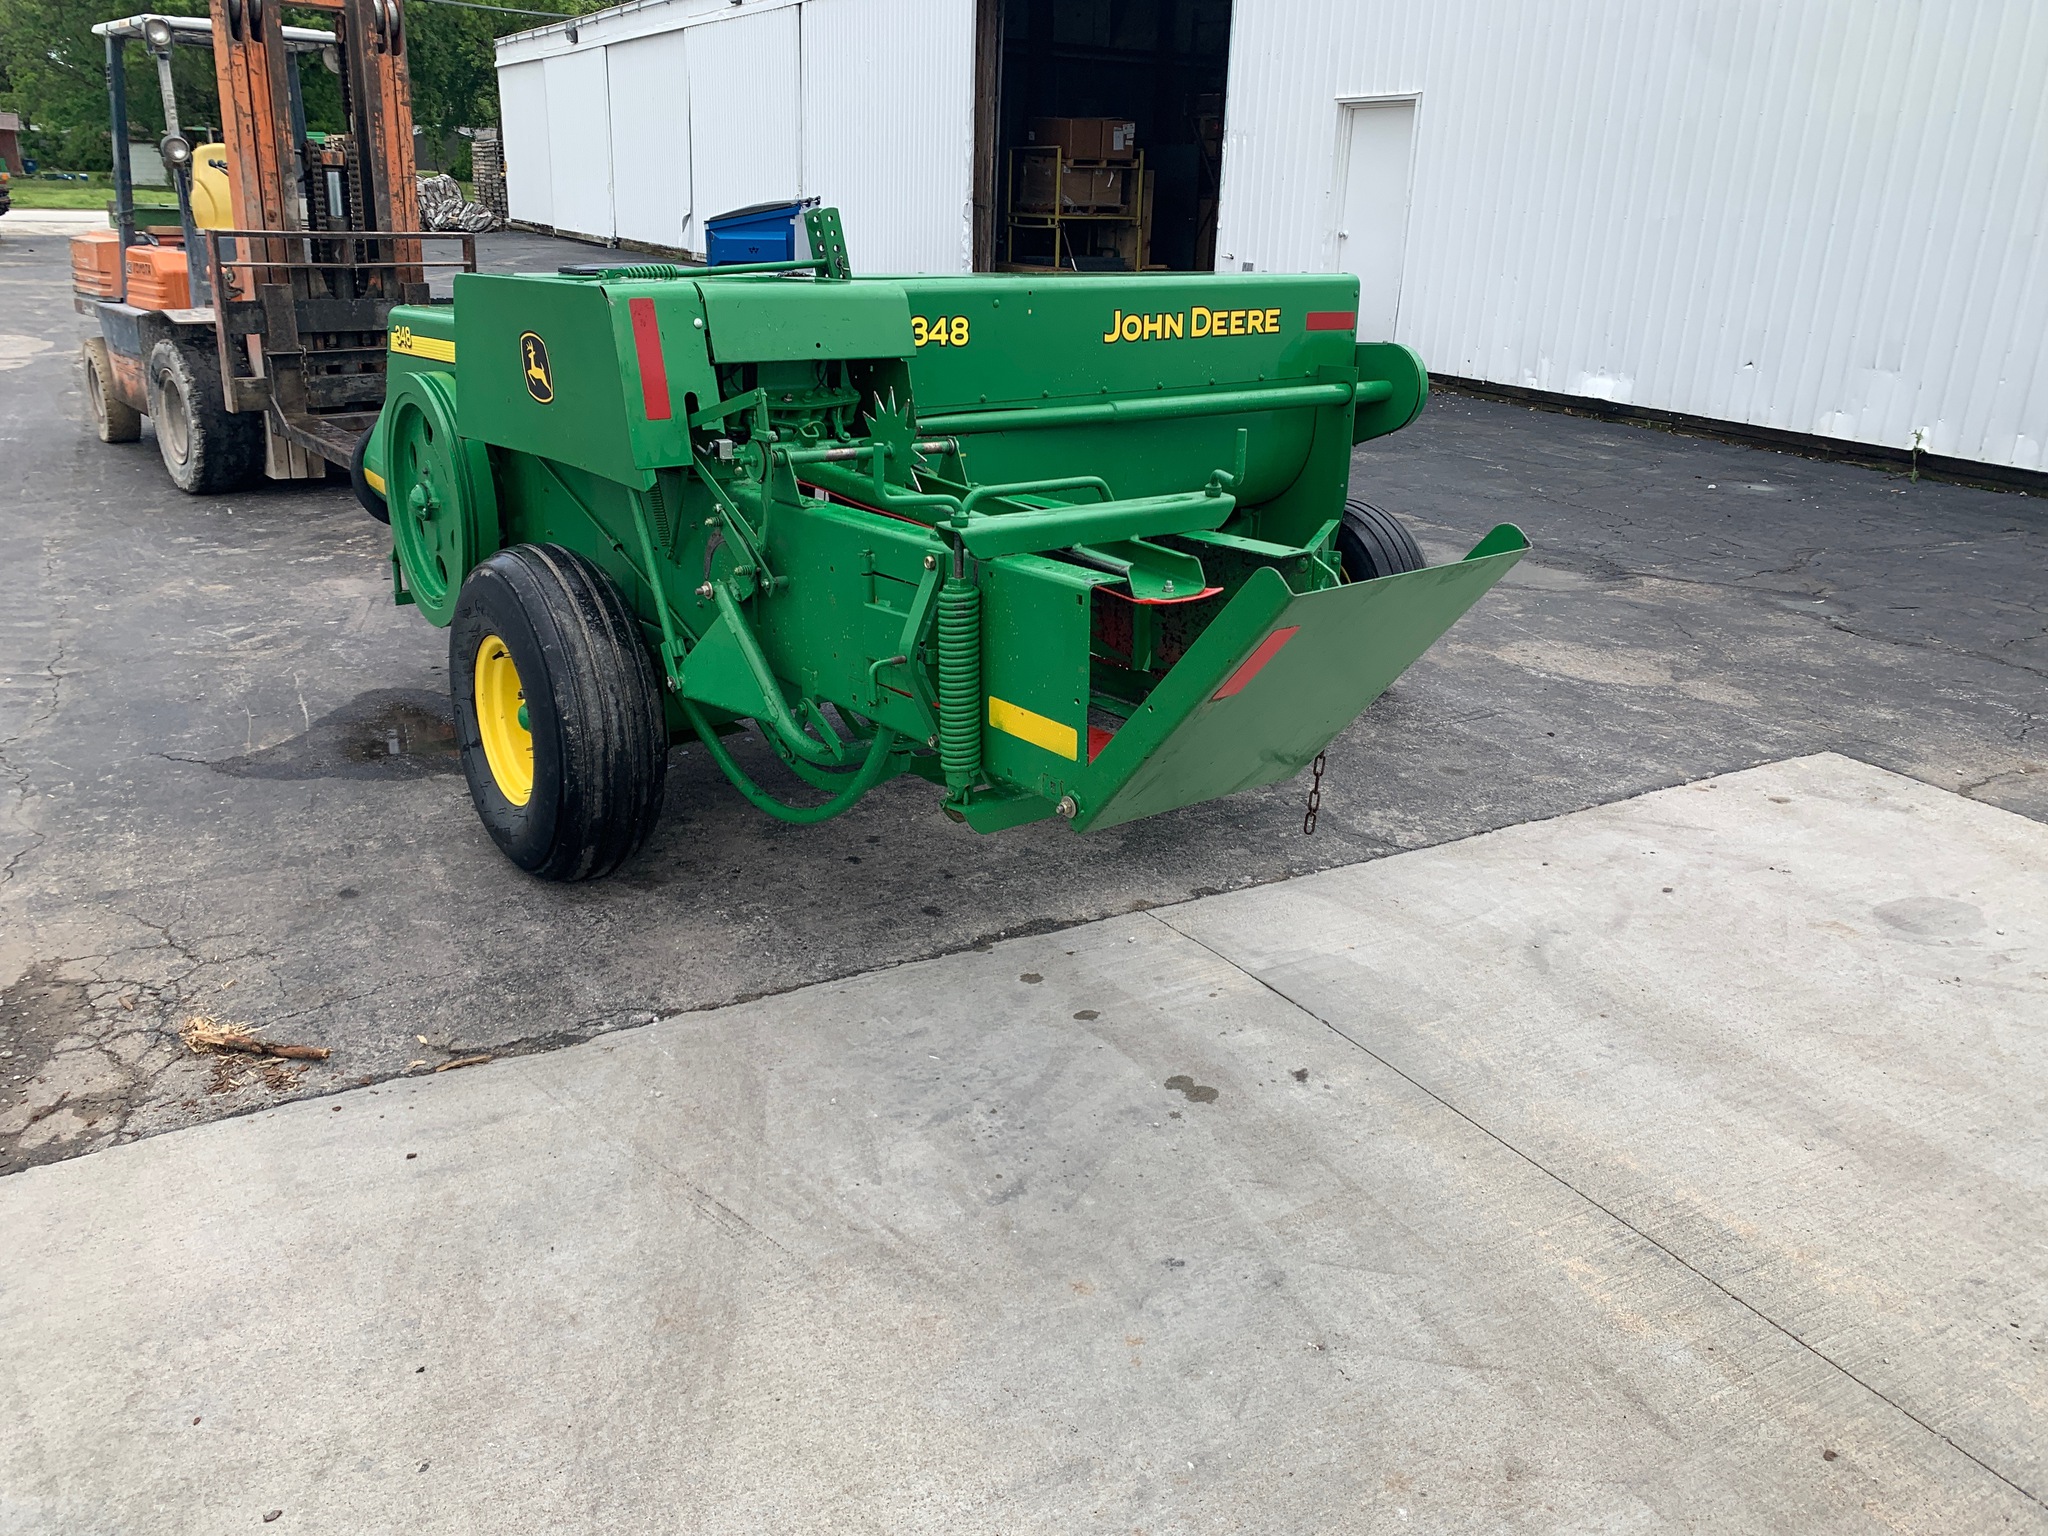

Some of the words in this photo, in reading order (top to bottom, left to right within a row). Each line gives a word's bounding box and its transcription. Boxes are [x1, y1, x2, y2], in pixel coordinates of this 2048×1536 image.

[394, 324, 413, 348] 348
[910, 314, 971, 348] 348
[1103, 308, 1184, 344] JOHN
[1189, 306, 1282, 338] DEERE
